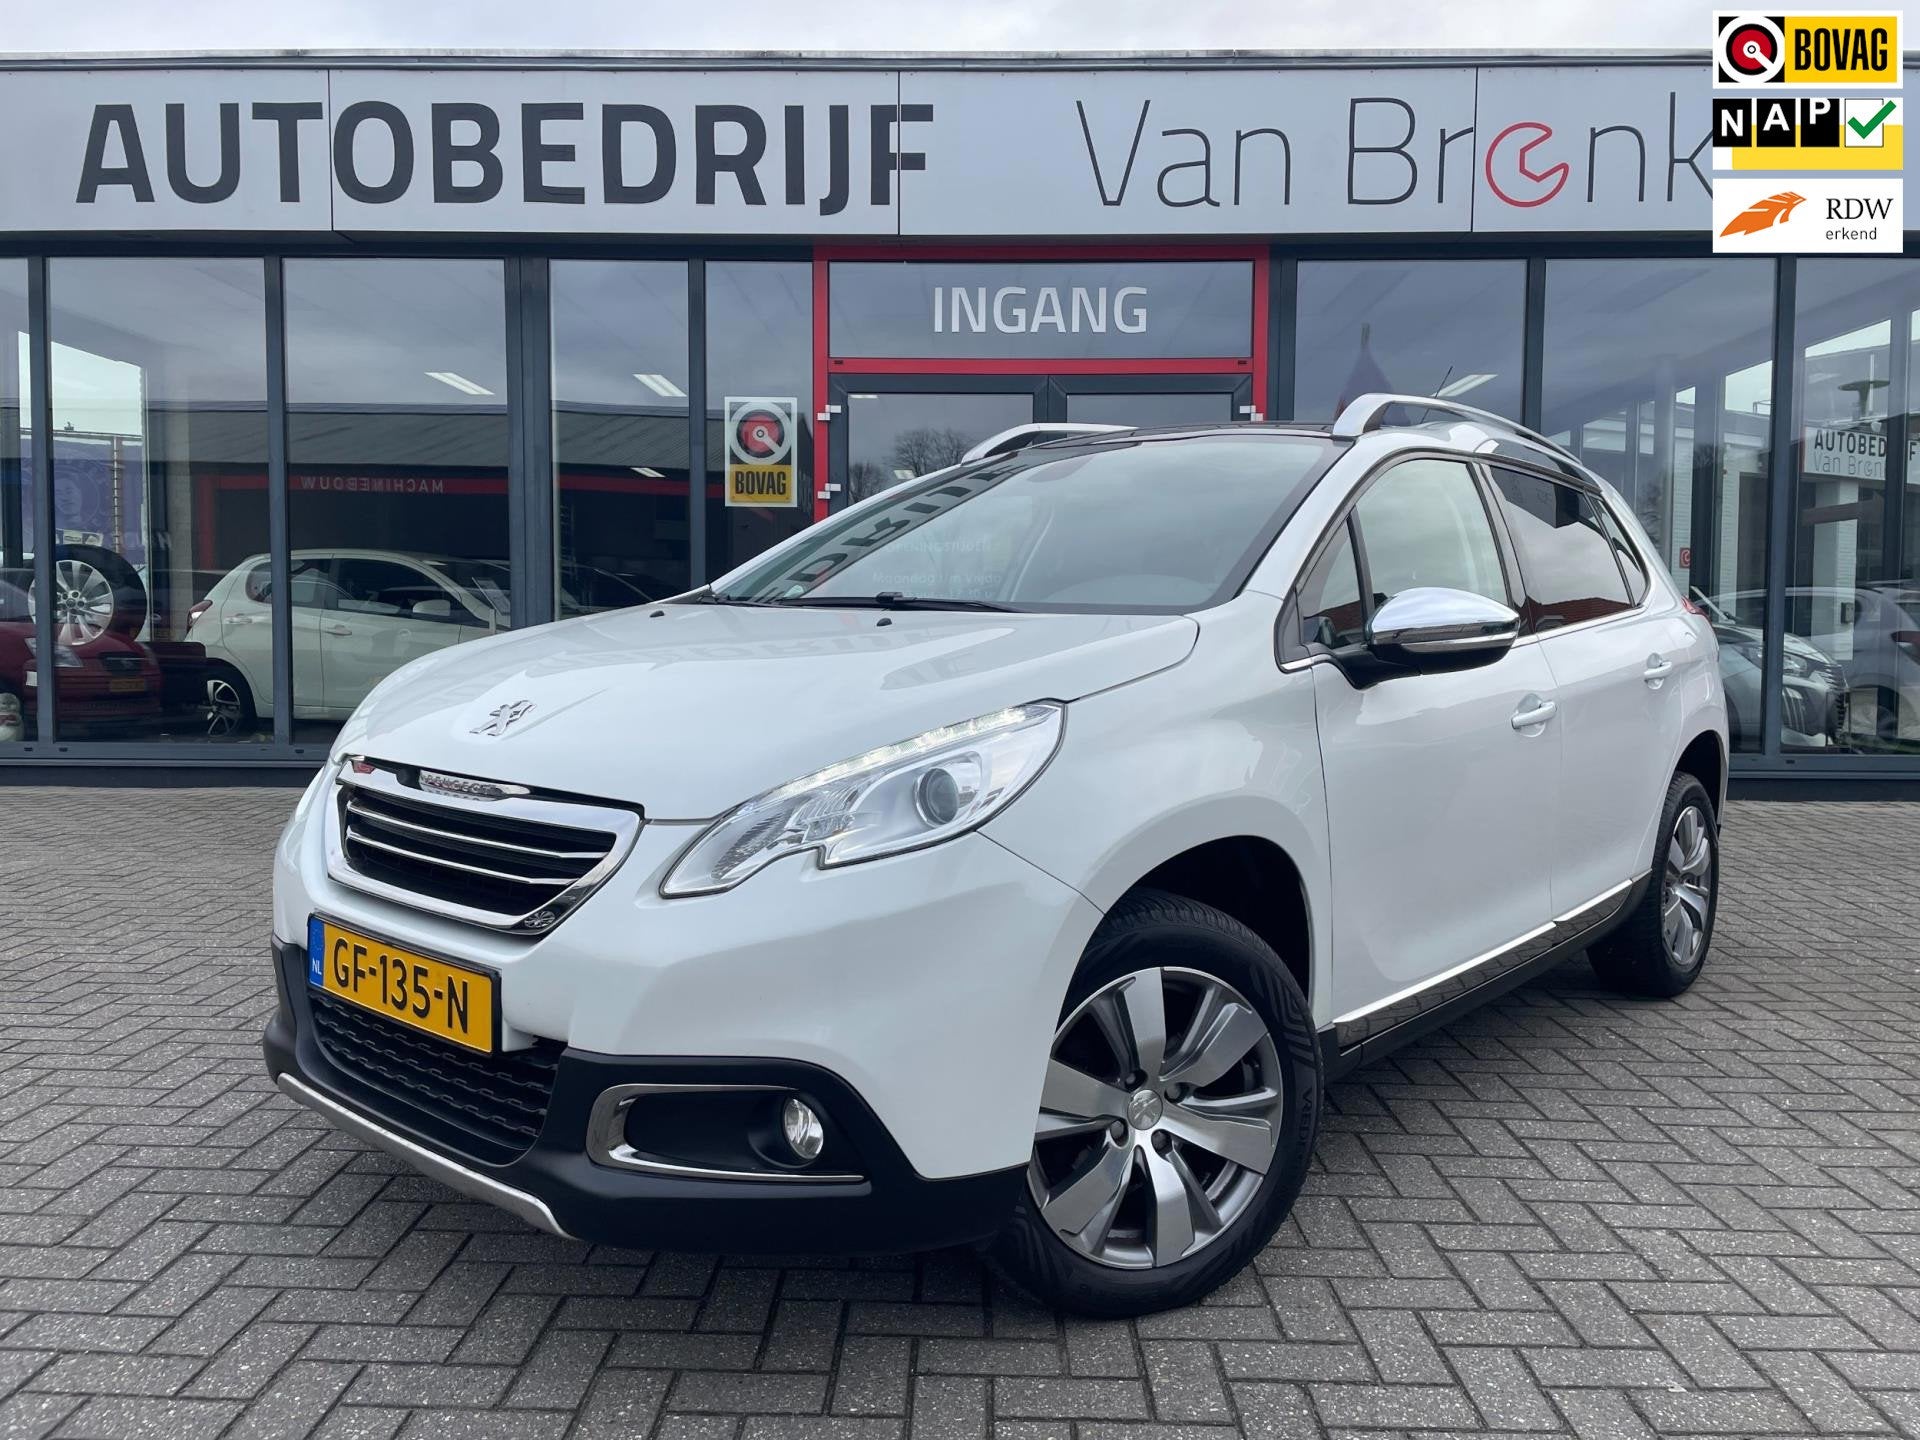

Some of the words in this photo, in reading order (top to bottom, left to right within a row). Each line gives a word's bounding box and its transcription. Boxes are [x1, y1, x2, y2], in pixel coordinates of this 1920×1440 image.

[76, 101, 934, 216] AUTOBEDRIJF
[1075, 99, 1292, 208] Van
[933, 286, 1148, 334] INGANG
[734, 470, 787, 496] BOVAG
[312, 958, 323, 976] NL
[333, 937, 469, 1034] GF-135-N
